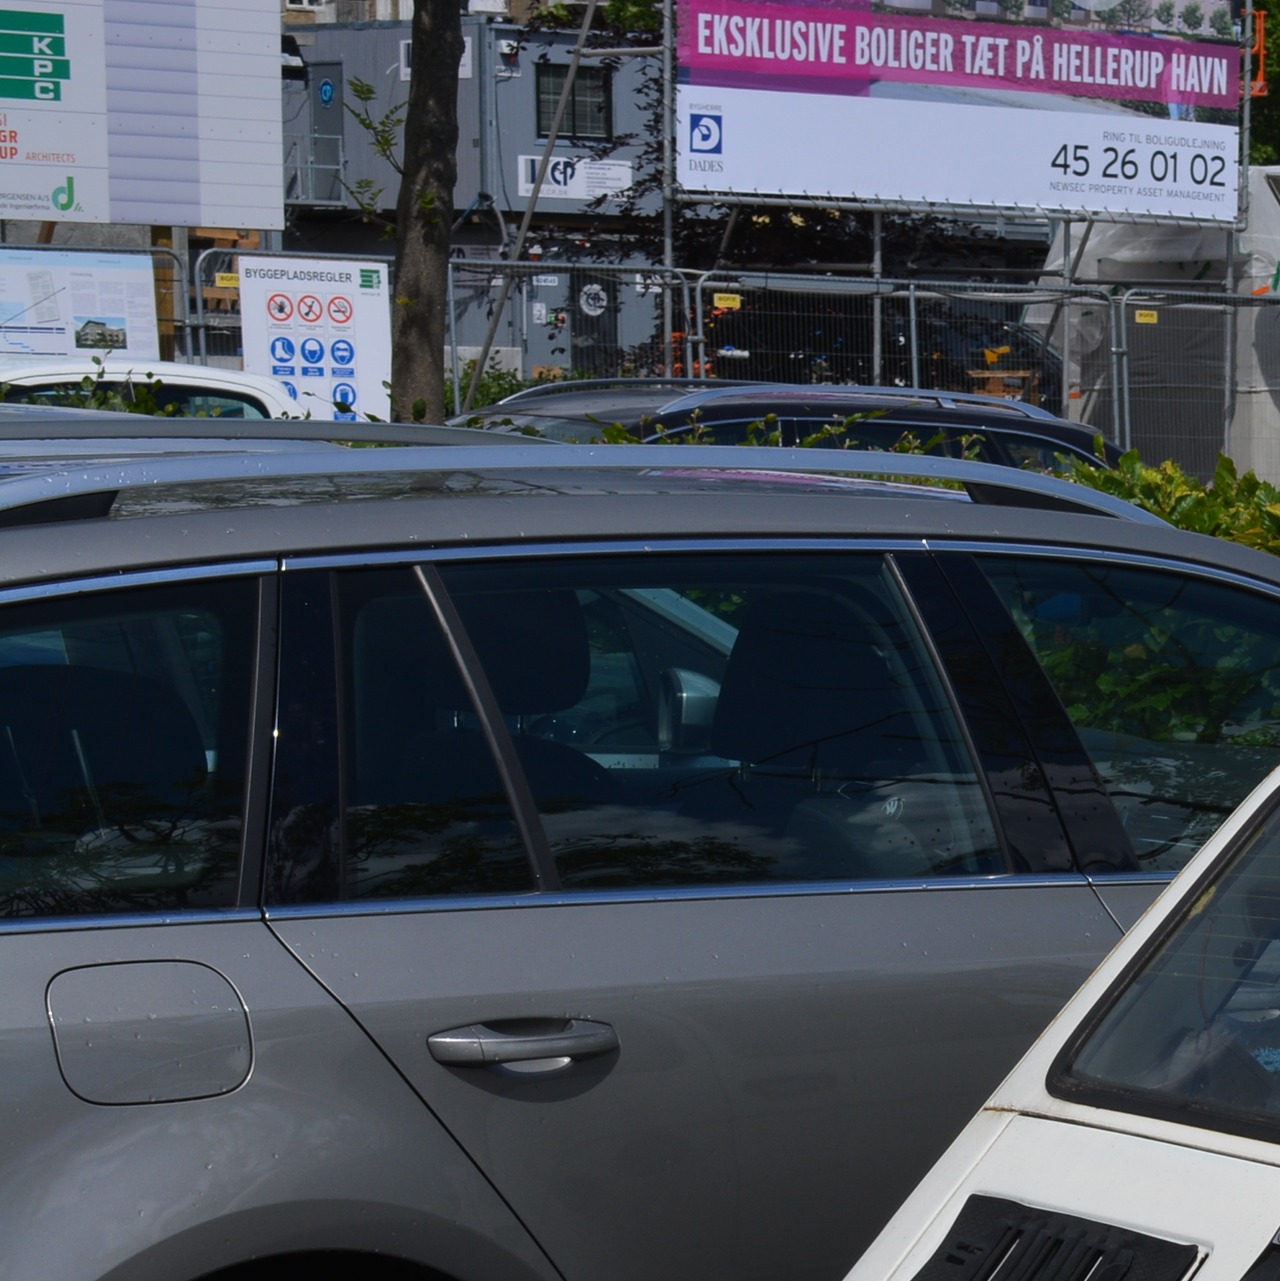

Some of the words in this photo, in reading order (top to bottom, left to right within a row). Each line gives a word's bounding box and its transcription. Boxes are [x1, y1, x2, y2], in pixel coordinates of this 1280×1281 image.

[698, 13, 846, 64] EKSKLUSIVE
[855, 26, 954, 72] BOLIGER
[962, 35, 1008, 76] TÆT
[1016, 35, 1045, 79] PÅ
[1053, 43, 1164, 88] HELLERUP
[1171, 53, 1227, 95] HAVN
[1103, 131, 1125, 143] RING
[1129, 133, 1143, 144] TIL
[1145, 135, 1226, 151] BOLIGUDLEJNING
[25, 152, 76, 163] ARCHITECTS
[689, 159, 723, 172] DADES
[1051, 144, 1090, 177] 45
[1102, 147, 1139, 180] 26
[1150, 150, 1178, 183] 01
[1190, 154, 1226, 187] 02
[1050, 182, 1086, 193] NEWSEC
[1088, 183, 1134, 196] PROPERTY
[1136, 187, 1163, 198] ASSET
[1166, 189, 1226, 203] MANAGEMENT
[245, 268, 352, 283] BYGGEPLADSREGLER
